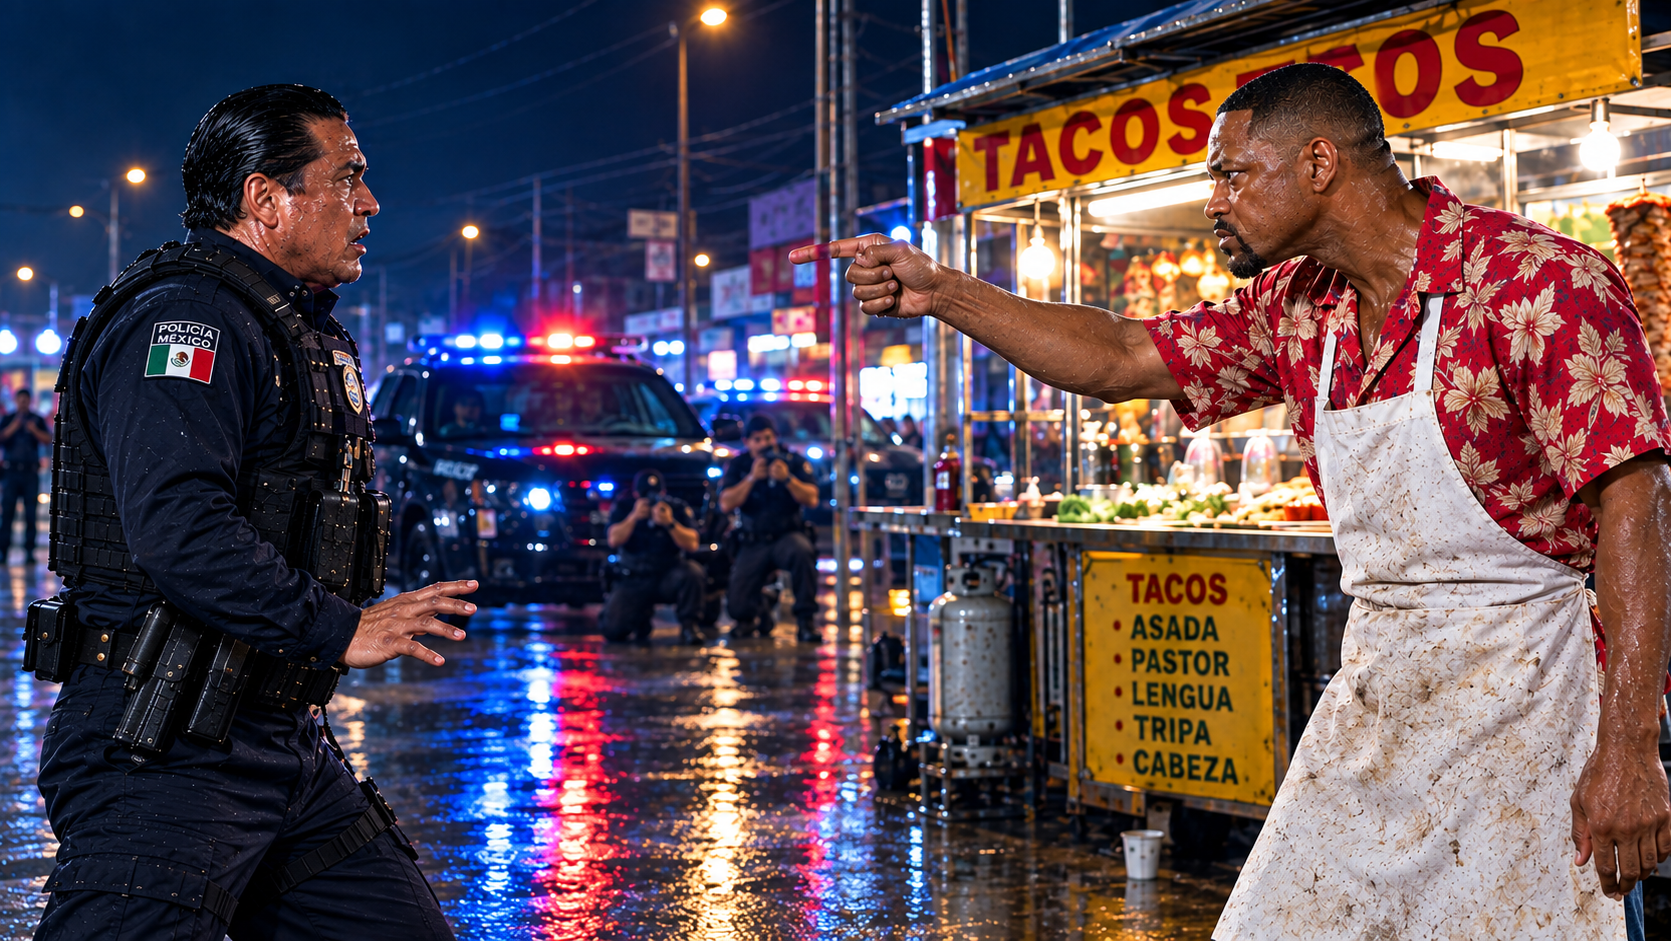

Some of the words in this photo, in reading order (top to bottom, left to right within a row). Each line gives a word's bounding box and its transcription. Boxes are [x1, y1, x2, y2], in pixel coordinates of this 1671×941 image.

[974, 83, 1213, 192] TACOS
[1126, 573, 1228, 606] TACOS
[1130, 614, 1219, 642] ASADA
[1131, 648, 1230, 676] PASTOR
[1132, 681, 1233, 712] LENGUA
[1133, 714, 1212, 746] TRIPA
[1133, 749, 1239, 785] CABEZA
